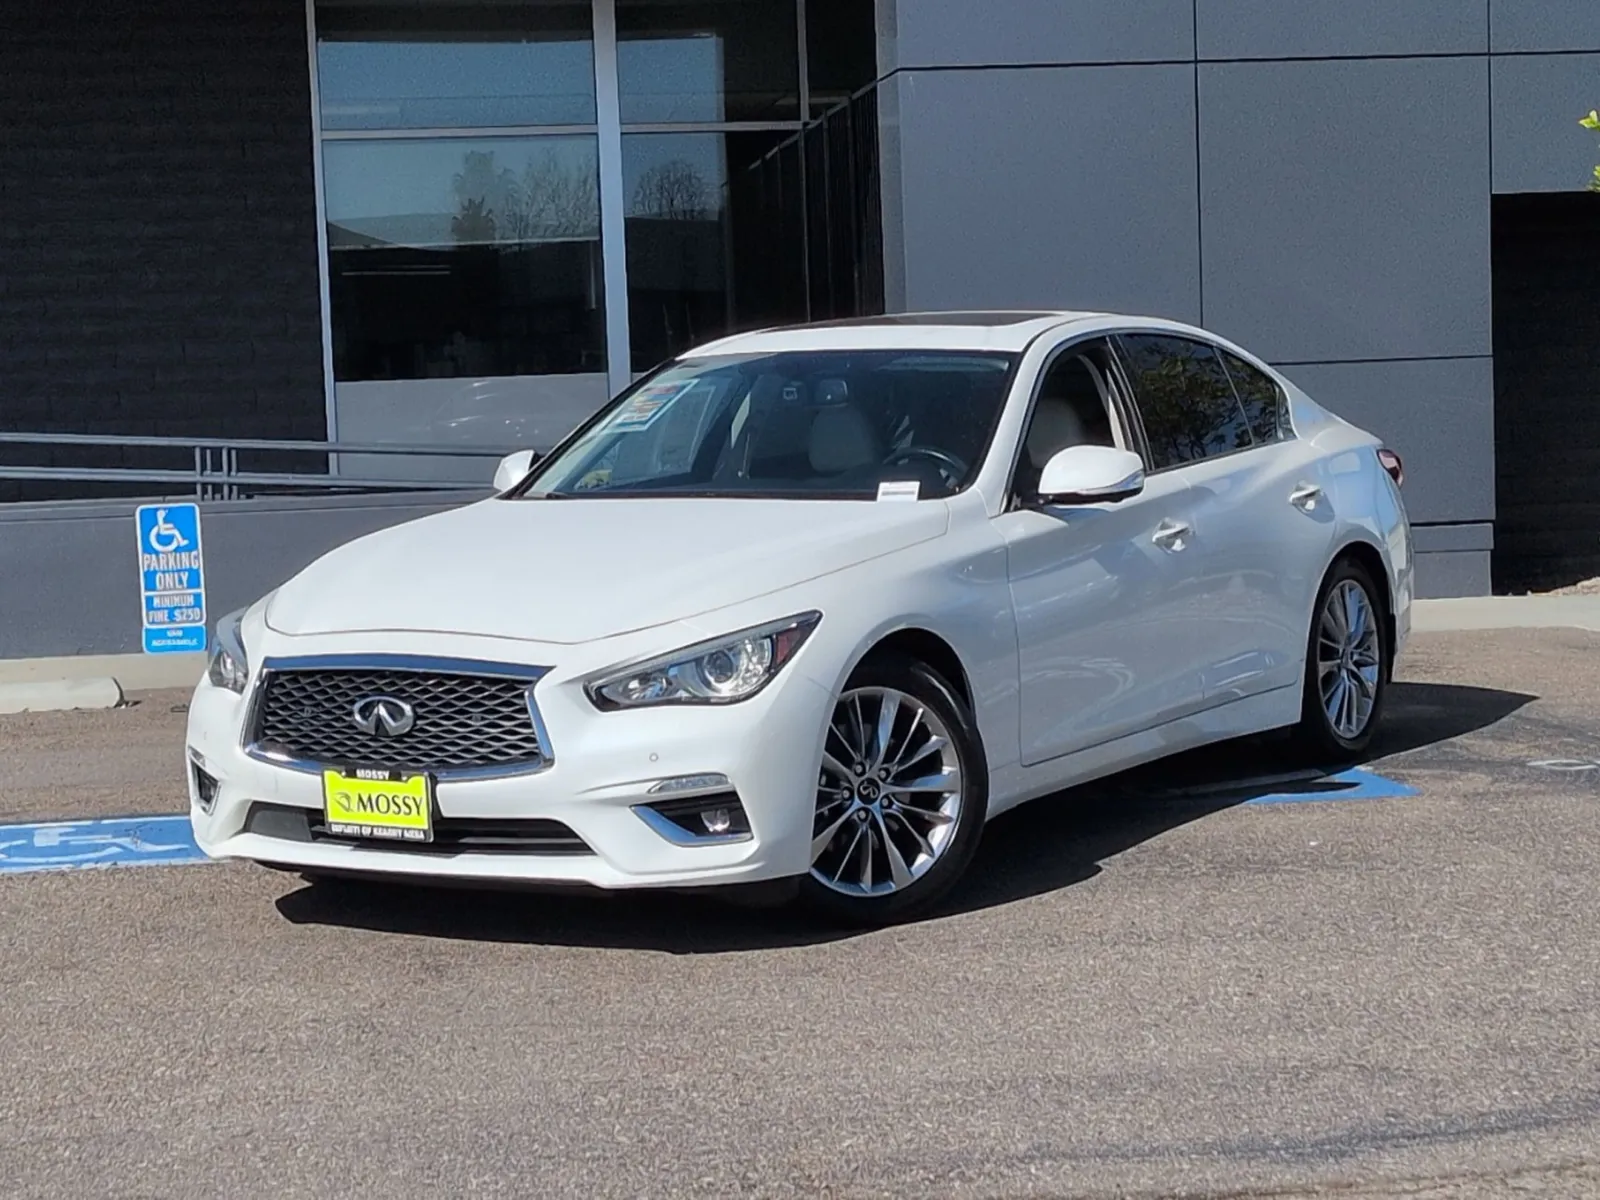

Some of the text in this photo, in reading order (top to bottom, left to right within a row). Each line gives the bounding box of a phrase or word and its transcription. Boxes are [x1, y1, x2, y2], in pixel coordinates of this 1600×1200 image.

[143, 550, 200, 572] PARKING
[156, 571, 189, 590] ONLY
[153, 594, 194, 608] MINIMUM
[356, 769, 389, 780] MOSSY
[357, 792, 422, 817] MOSSY
